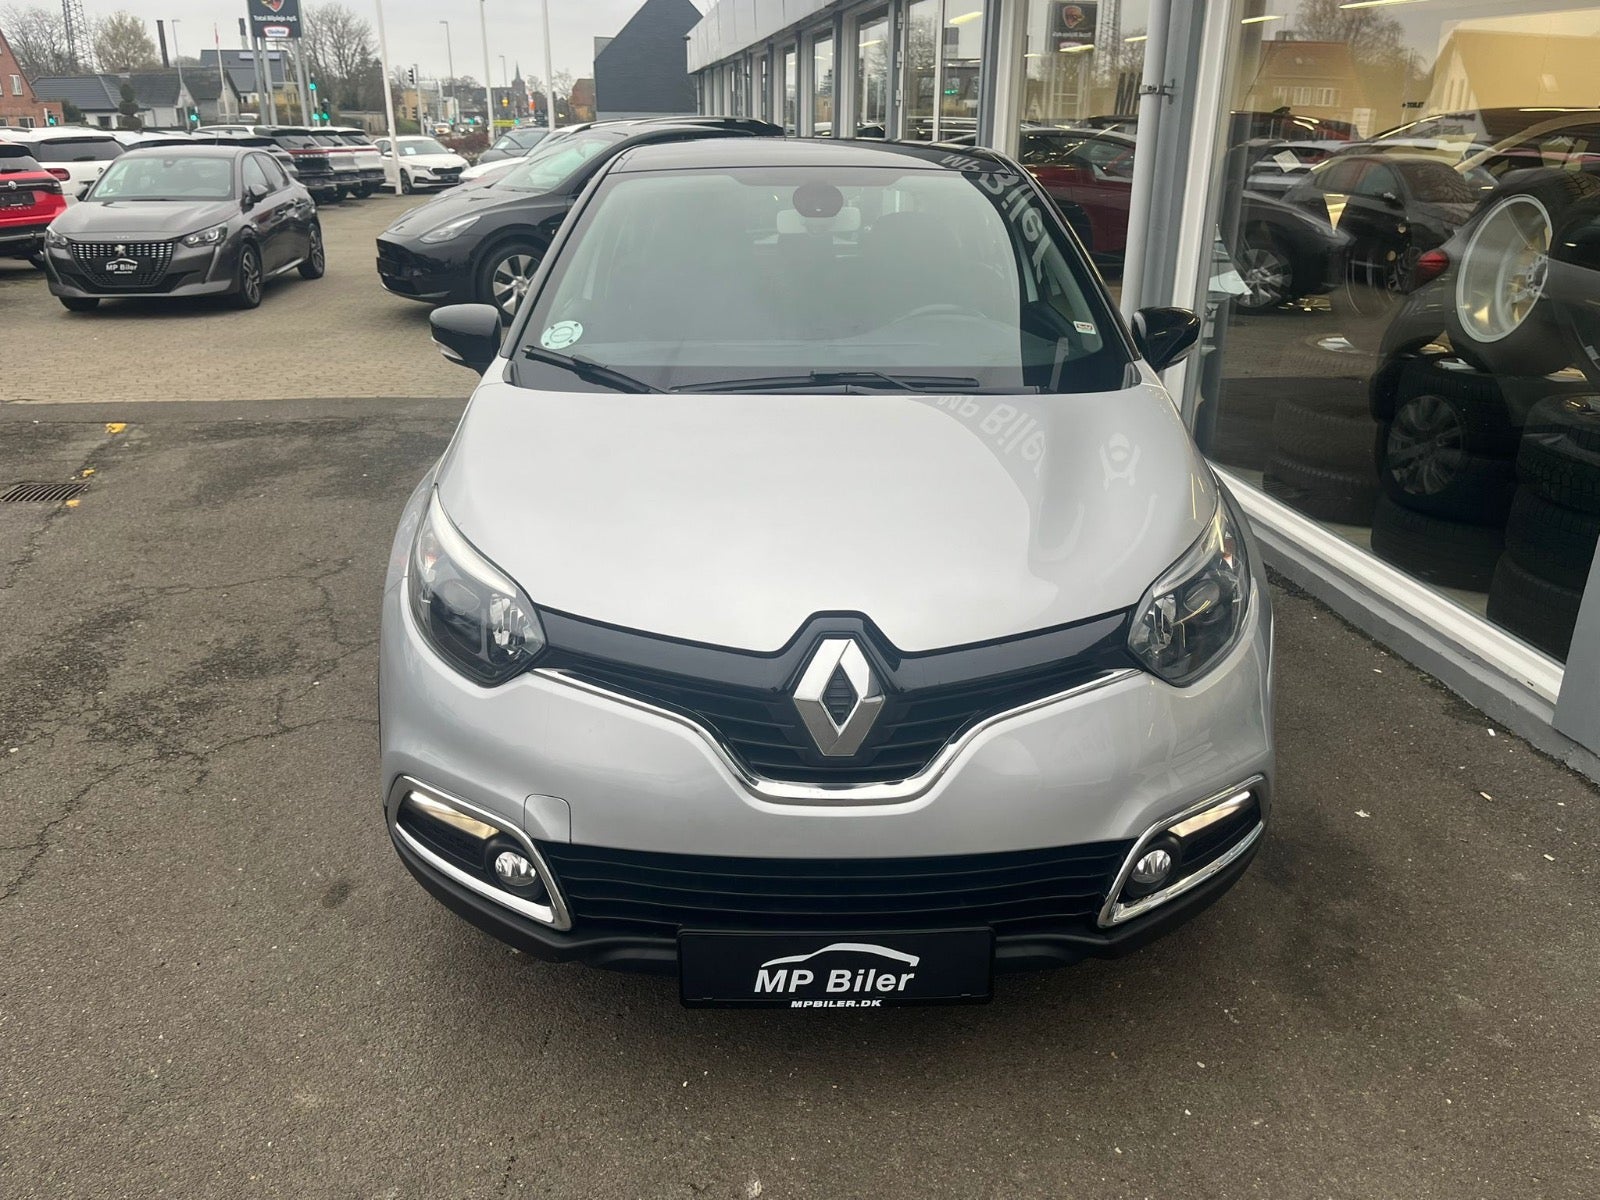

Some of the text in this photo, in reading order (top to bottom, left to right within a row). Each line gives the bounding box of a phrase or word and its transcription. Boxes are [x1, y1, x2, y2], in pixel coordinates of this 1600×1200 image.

[754, 968, 915, 993] MP Biler
[790, 999, 882, 1008] MPBILER.DK
